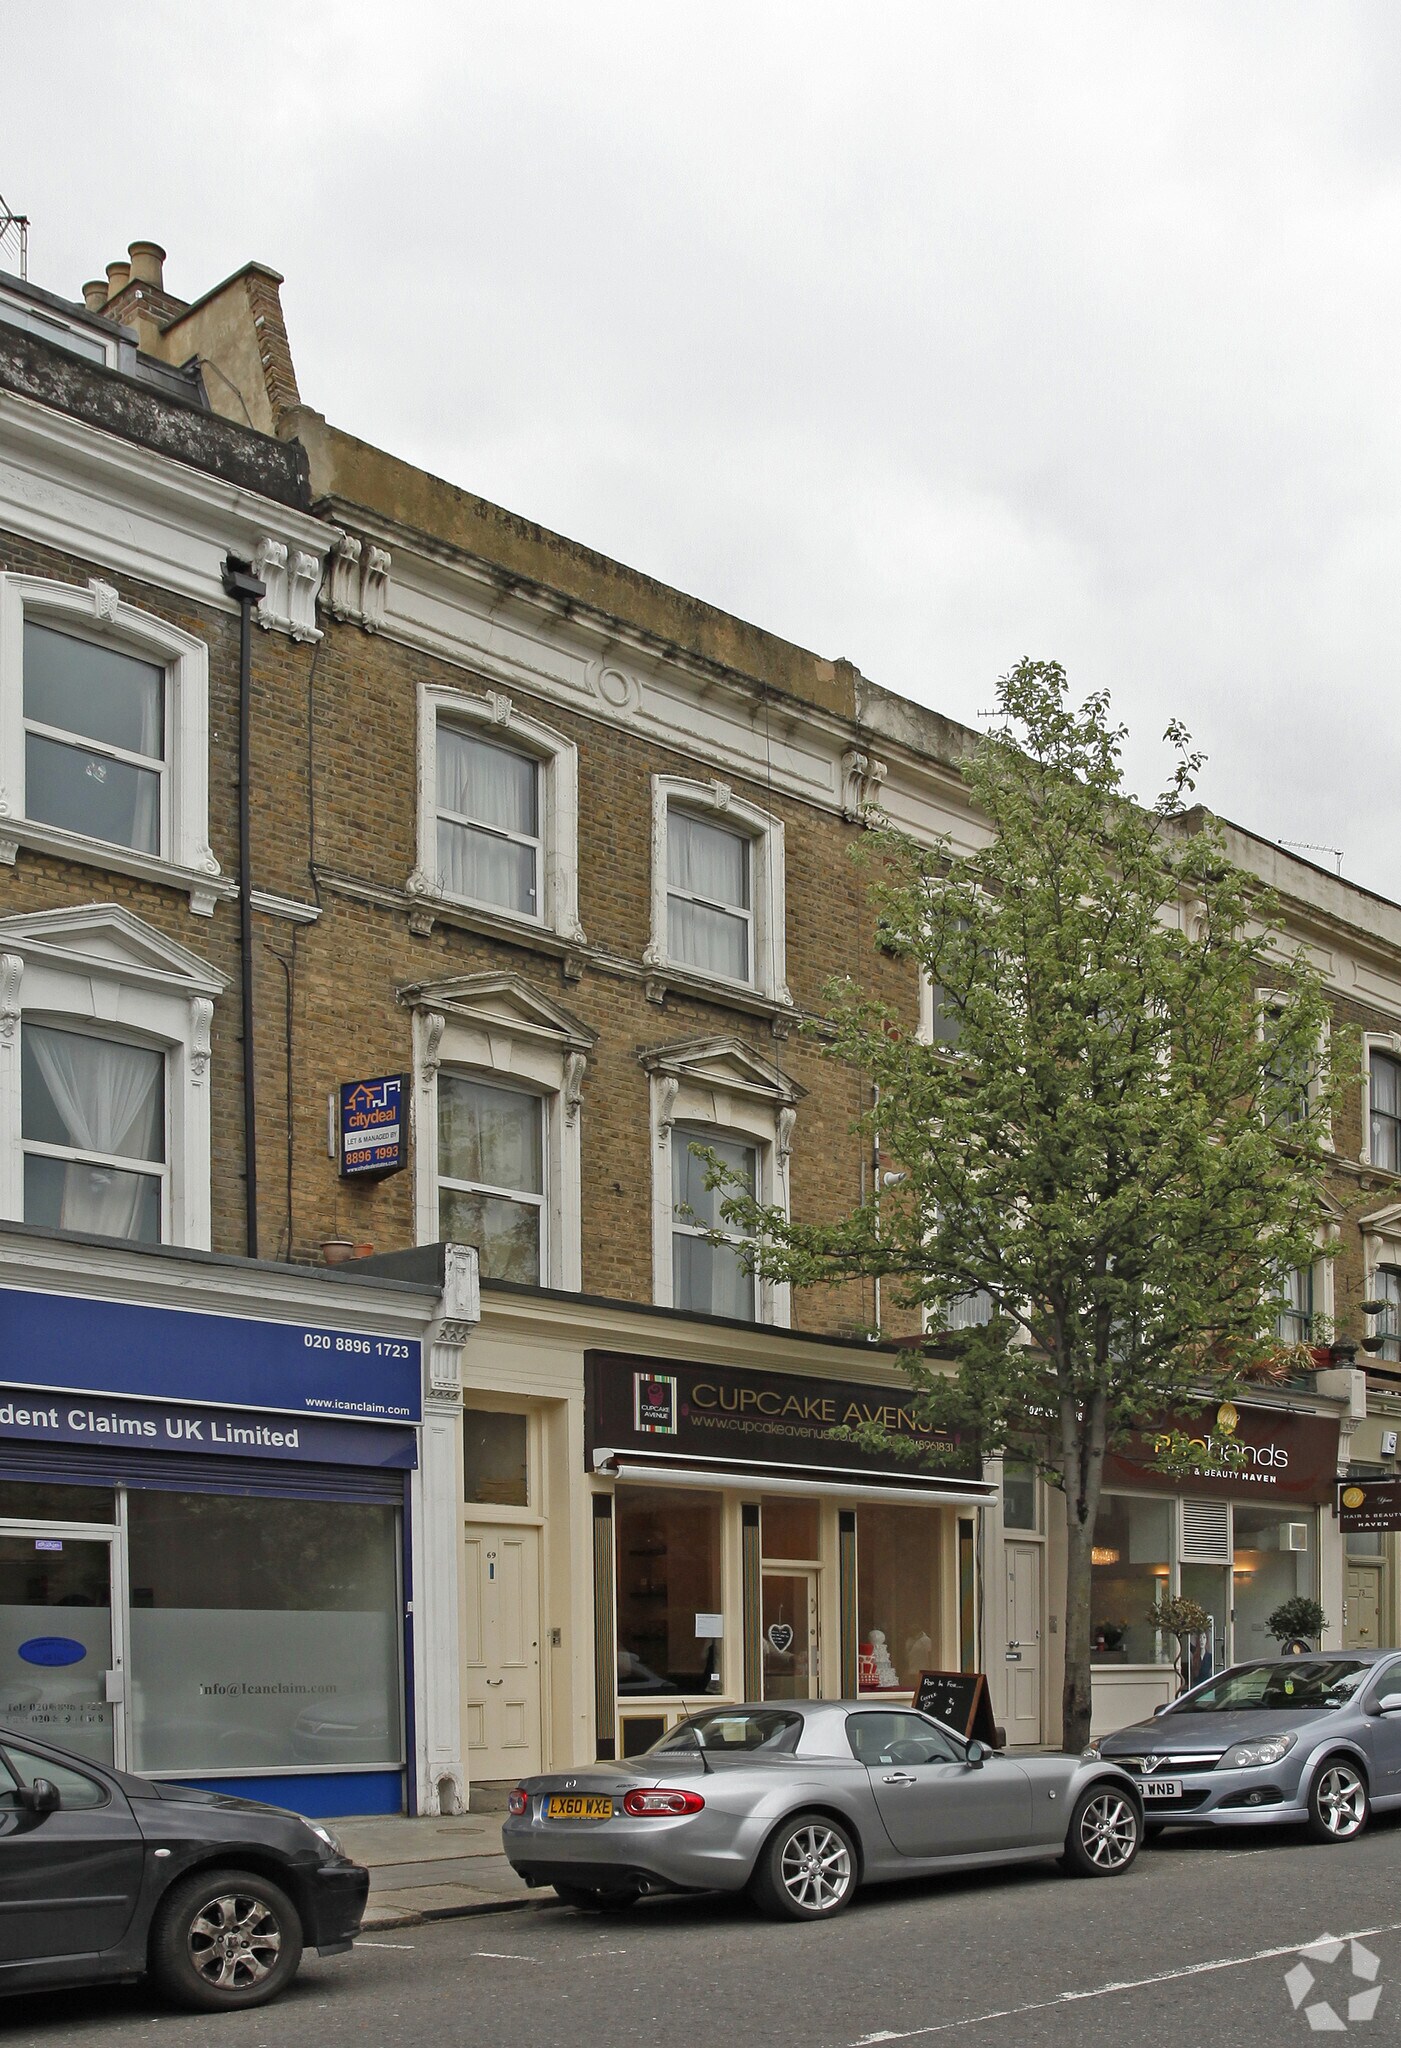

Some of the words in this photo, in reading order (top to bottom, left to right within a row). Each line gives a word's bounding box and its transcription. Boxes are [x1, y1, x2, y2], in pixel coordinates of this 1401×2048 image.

[349, 1106, 396, 1128] citydeal
[347, 1138, 357, 1146] LET
[363, 1132, 389, 1142] MANAGED
[346, 1150, 371, 1165] 8896
[375, 1145, 399, 1160] 1993
[304, 1334, 331, 1349] 020
[335, 1338, 371, 1354] 8896
[375, 1342, 409, 1359] 1723
[305, 1398, 410, 1415] www.icanclaim.com
[692, 1383, 836, 1422] CUPCAKE
[644, 1411, 669, 1420] AVENUE
[67, 1409, 157, 1437] Claims
[165, 1418, 203, 1440] UK
[210, 1421, 299, 1448] Limited
[1194, 1467, 1200, 1476] &
[1204, 1469, 1240, 1480] BEAUTY
[1241, 1473, 1277, 1484] HAVEN
[486, 1551, 496, 1559] 69
[1147, 1784, 1174, 1795] WNB
[550, 1798, 583, 1814] LX60
[586, 1798, 612, 1814] WXE
